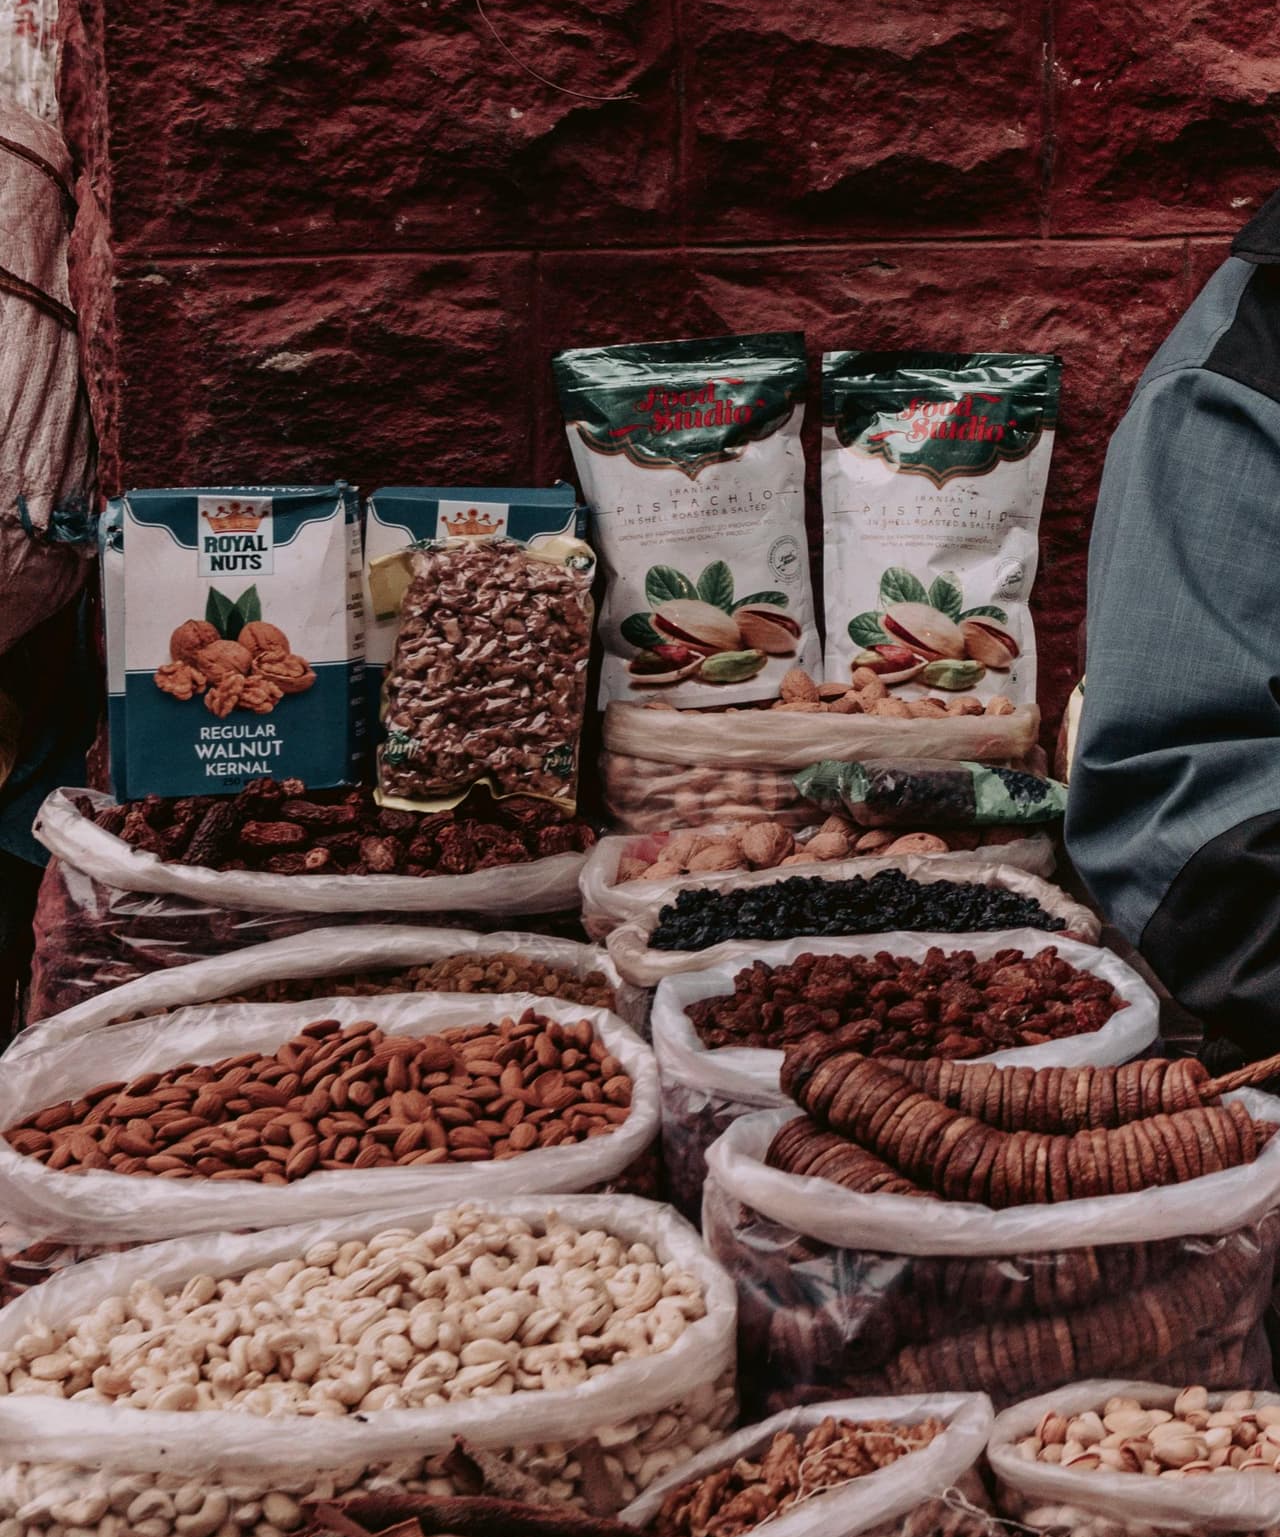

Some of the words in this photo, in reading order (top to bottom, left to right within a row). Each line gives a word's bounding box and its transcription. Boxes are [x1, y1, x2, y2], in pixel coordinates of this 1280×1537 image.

[633, 379, 733, 412] Food
[896, 393, 990, 421] Food
[631, 399, 753, 437] Studio
[882, 415, 1006, 443] Studio
[669, 485, 720, 497] IRANIAN
[616, 489, 773, 516] PISTACHIO
[672, 509, 719, 521] ROASTED
[731, 503, 768, 515] SALTED
[863, 505, 1008, 522] PISTACHIO
[204, 535, 268, 554] ROYAL
[210, 554, 262, 571] NUTS
[200, 724, 277, 740] REGULAR
[195, 740, 284, 760] WALNUT
[205, 760, 272, 776] KERNAL
